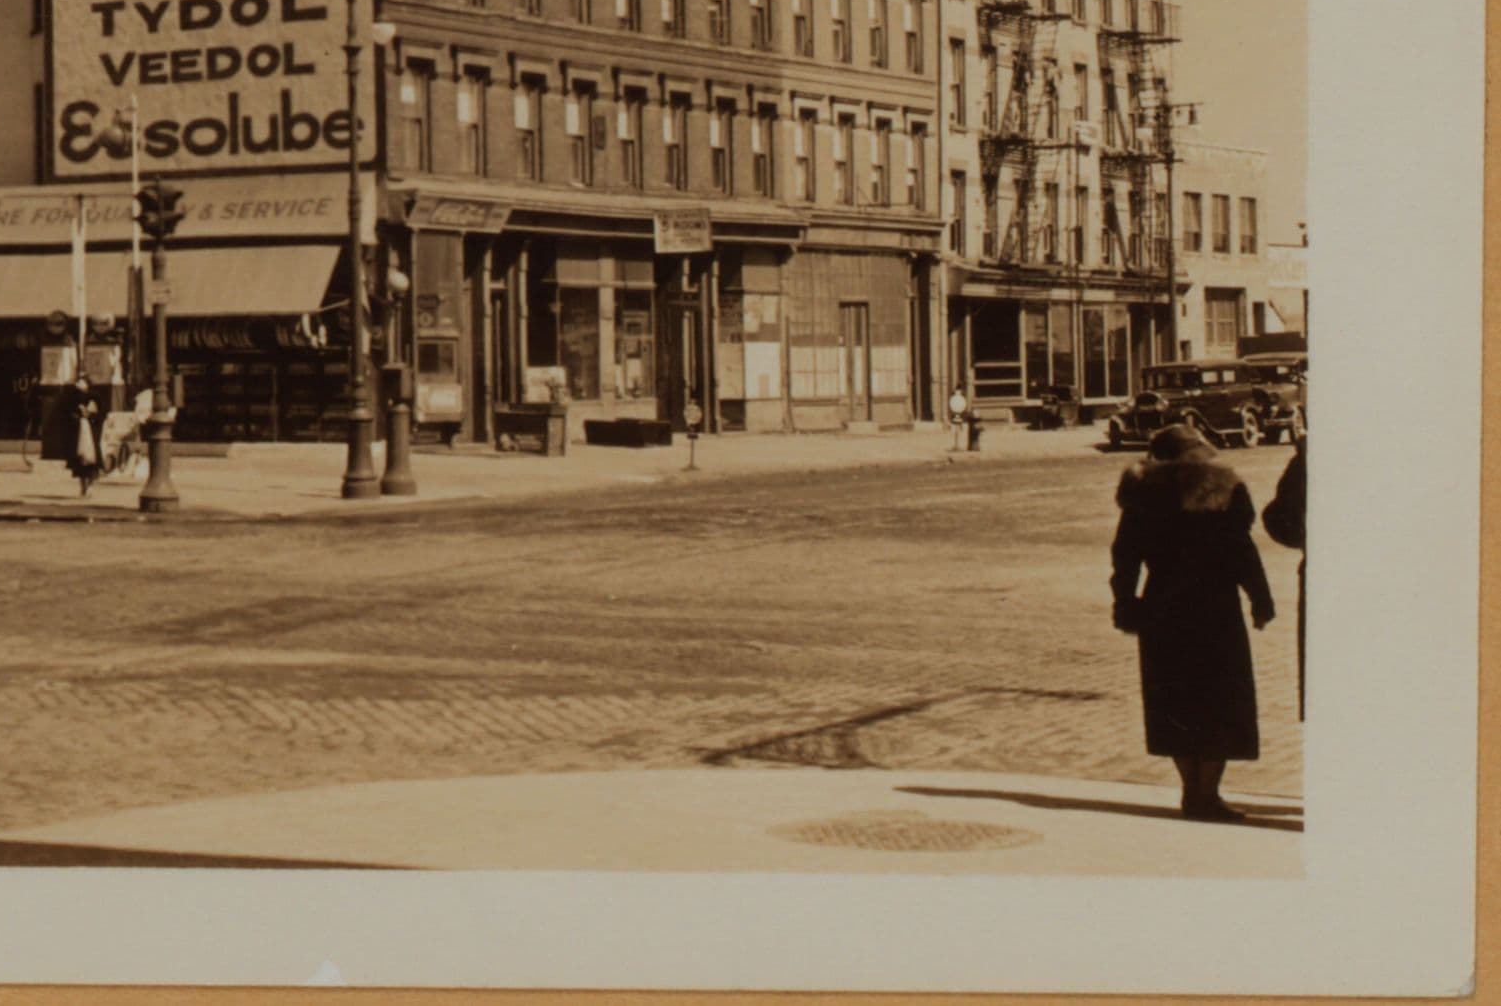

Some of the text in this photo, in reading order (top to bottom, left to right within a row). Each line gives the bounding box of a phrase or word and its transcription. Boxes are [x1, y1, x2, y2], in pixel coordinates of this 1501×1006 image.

[99, 42, 315, 86] VEEDOL
[31, 206, 77, 226] FOR
[86, 203, 195, 225] QUAY
[199, 202, 214, 221] &
[219, 197, 333, 221] SERVICE
